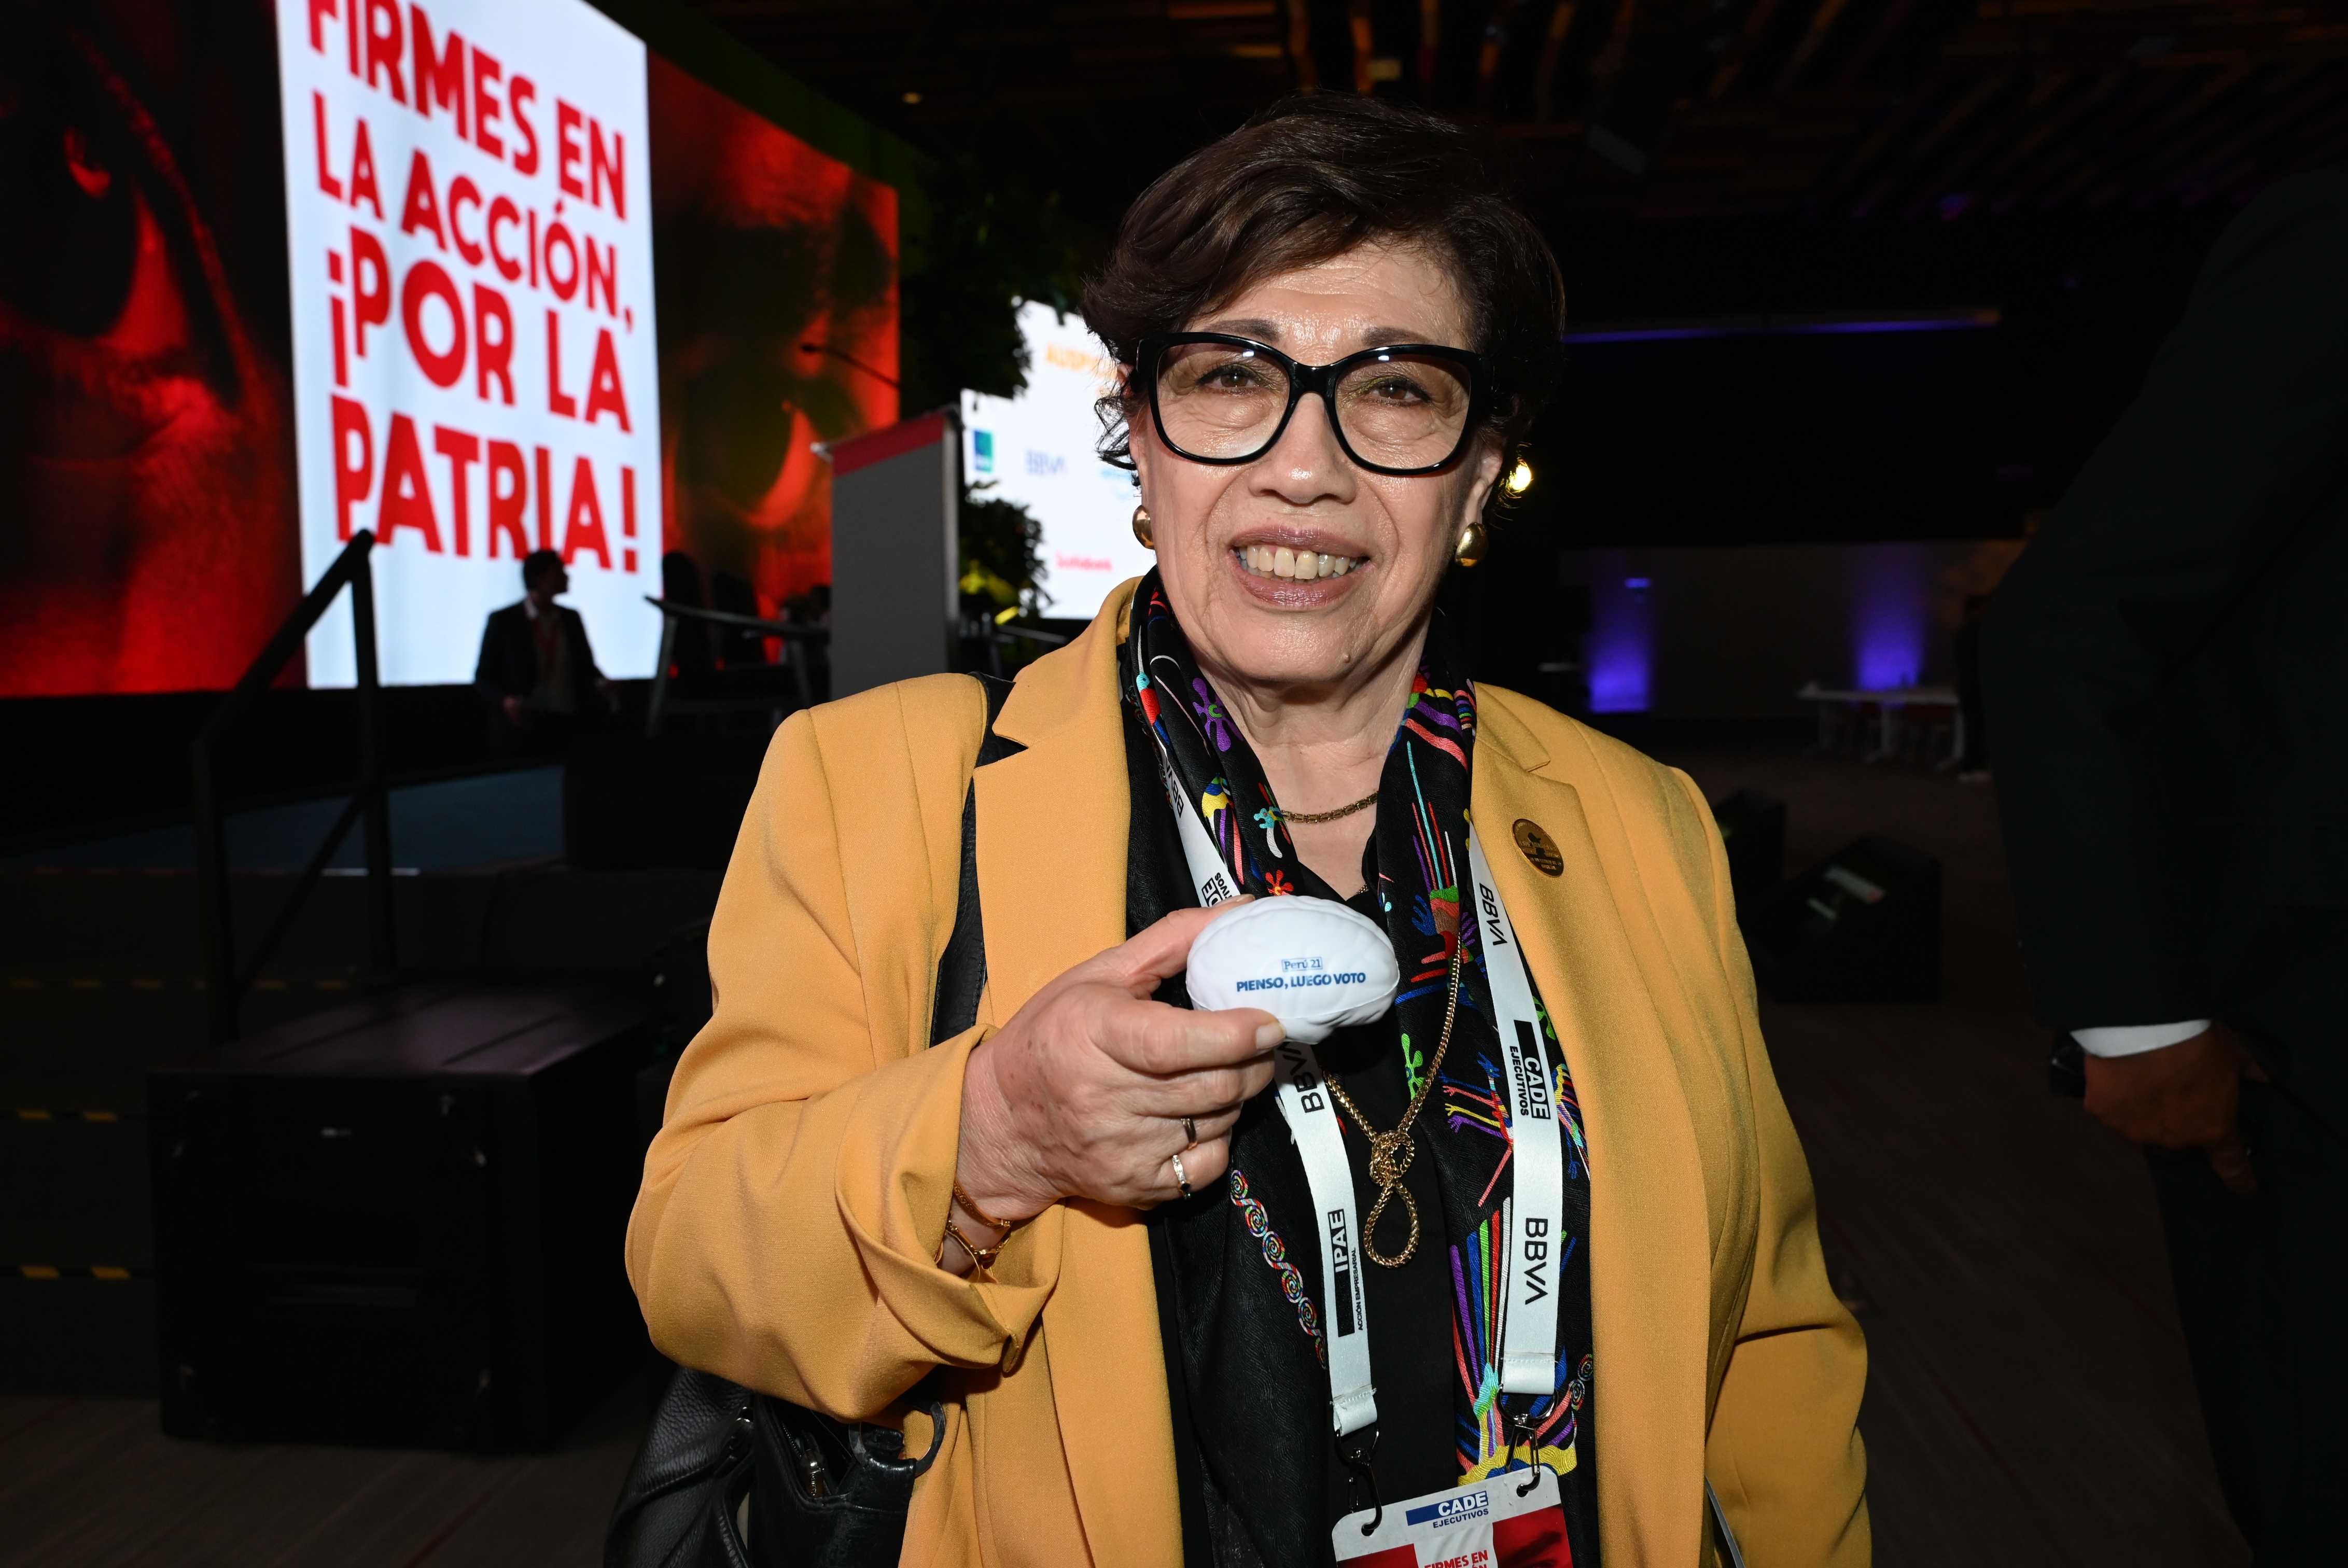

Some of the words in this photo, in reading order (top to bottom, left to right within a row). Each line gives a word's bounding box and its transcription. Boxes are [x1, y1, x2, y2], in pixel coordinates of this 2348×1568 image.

[307, 0, 540, 179] FIRMES
[555, 96, 627, 222] EN
[312, 88, 385, 222] LA
[399, 147, 634, 332] ACCIÓN,
[327, 223, 516, 407] ¡POR
[545, 308, 633, 435] LA
[330, 392, 639, 573] PATRIA!
[1479, 883, 1508, 946] BBVA
[1236, 977, 1289, 992] PIENSO,
[1290, 974, 1332, 987] LUEGO
[1333, 972, 1366, 984] VOTO
[1284, 959, 1308, 970] Perú
[1311, 959, 1321, 968] 21
[1510, 1045, 1529, 1116] EJECUTIVOS
[1524, 1057, 1550, 1118] CADE
[1329, 1210, 1348, 1273] IPAE
[1524, 1217, 1548, 1305] BBVA
[1351, 1247, 1361, 1300] EMPRESARIAL
[1433, 1508, 1489, 1529] EJECUTIVOS
[1438, 1491, 1488, 1516] CADE
[1424, 1555, 1470, 1568] RMES
[1471, 1550, 1489, 1564] EN
